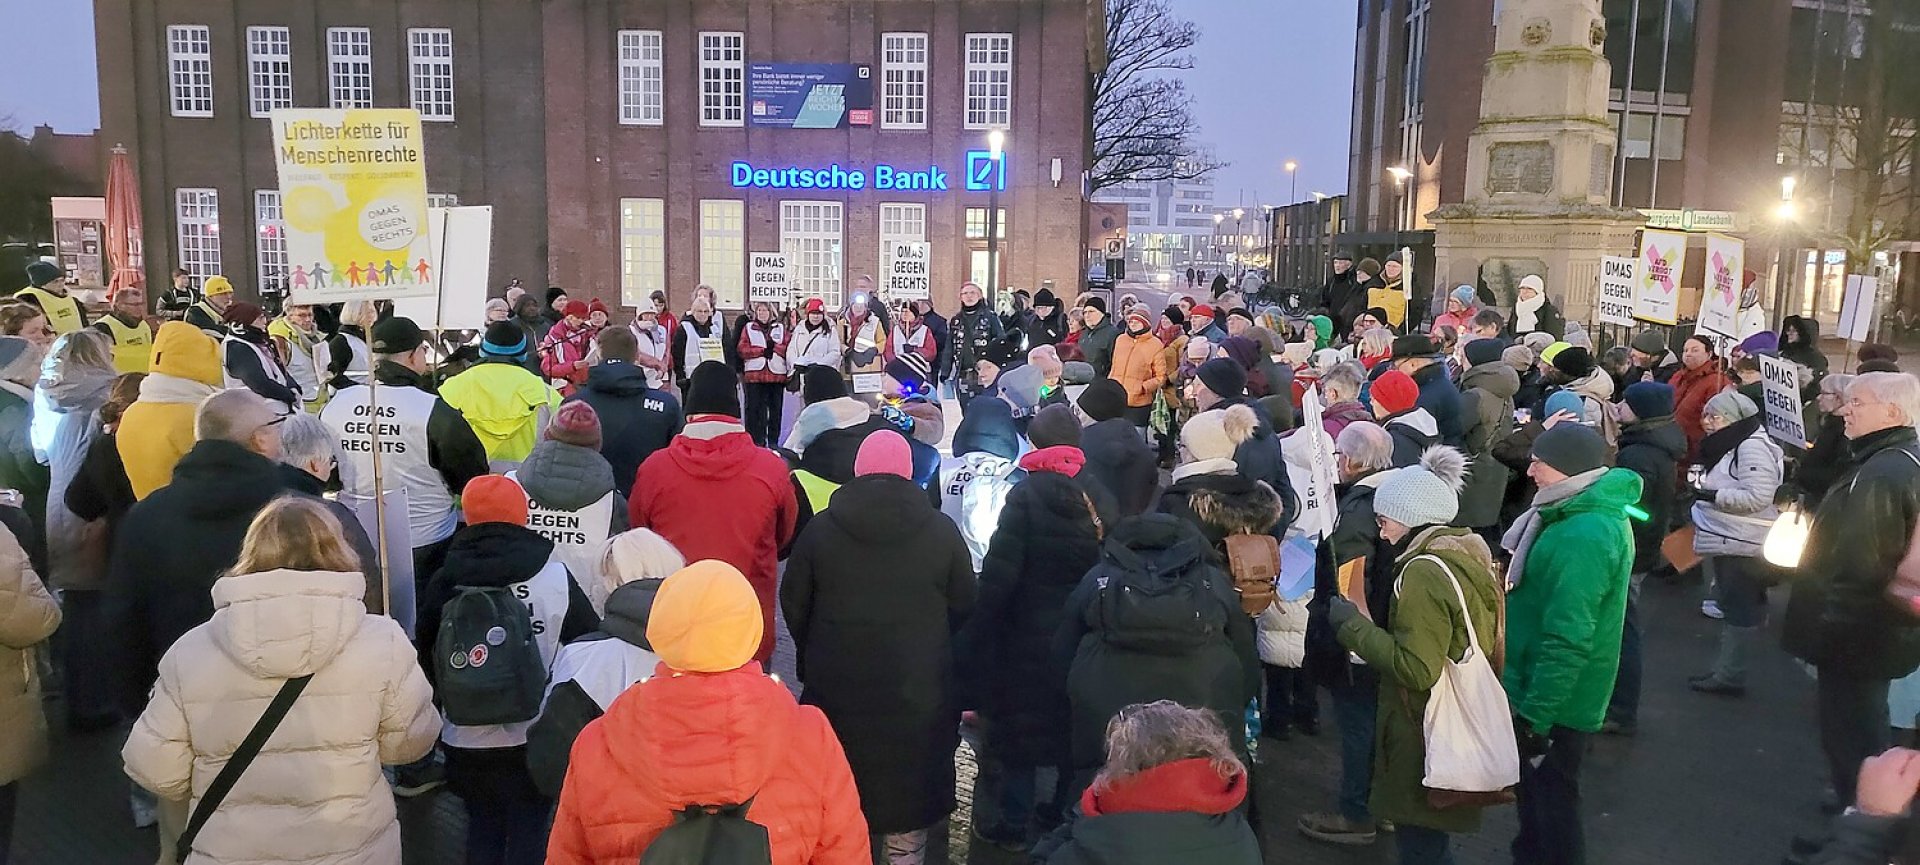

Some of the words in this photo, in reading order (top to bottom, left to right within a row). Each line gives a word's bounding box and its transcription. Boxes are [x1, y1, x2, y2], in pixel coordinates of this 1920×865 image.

[809, 84, 845, 95] JETZT
[283, 121, 383, 141] Lichterkette
[387, 121, 410, 139] für
[281, 145, 417, 165] Menschenrechte
[732, 162, 865, 189] Deutsche
[874, 164, 947, 190] Bank
[368, 205, 400, 219] OMAS
[370, 216, 407, 231] GEGEN
[372, 227, 413, 243] RECHTS
[897, 246, 924, 259] OMAS
[755, 257, 785, 268] OMAS
[894, 261, 925, 275] GEGEN
[1605, 261, 1632, 279] OMAS
[754, 273, 785, 283] GEGEN
[891, 276, 928, 290] RECHTS
[752, 287, 787, 297] RECHTS
[1604, 282, 1631, 299] GEGEN
[1601, 302, 1633, 319] RECHTS
[1764, 362, 1793, 389] OMAS
[643, 398, 664, 412] HH
[1767, 388, 1797, 415] GEGEN
[353, 405, 396, 418] OPAS
[344, 421, 400, 436] GEGEN
[1768, 412, 1803, 439] RECHTS
[341, 439, 406, 454] RECHTS
[534, 530, 586, 544] CHTS
